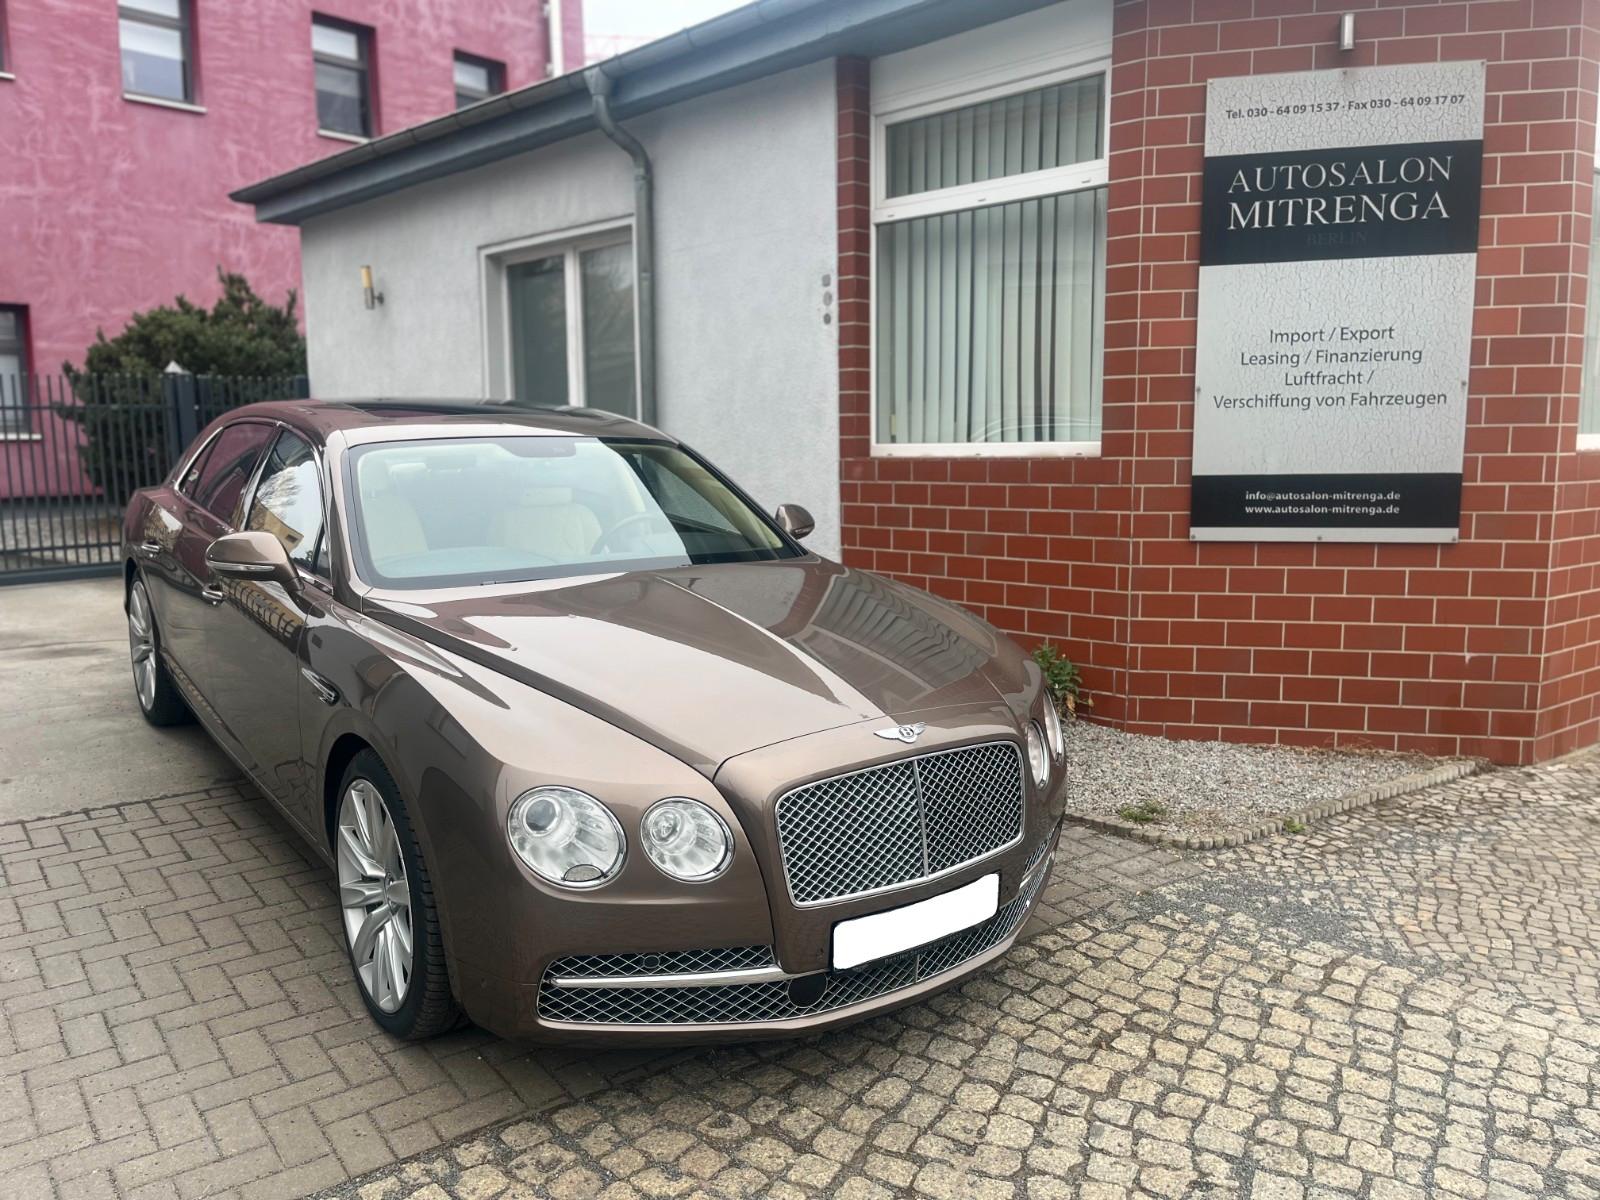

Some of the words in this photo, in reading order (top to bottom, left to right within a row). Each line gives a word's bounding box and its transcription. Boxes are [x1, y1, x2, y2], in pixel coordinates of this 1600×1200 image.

[1226, 109, 1245, 119] Tel.
[1293, 104, 1307, 114] 09
[1310, 103, 1323, 113] 15
[1325, 102, 1340, 112] 37
[1348, 101, 1368, 110] Fax
[1417, 96, 1431, 106] 09
[1435, 95, 1448, 105] 17
[1450, 94, 1465, 104] 07
[1227, 155, 1453, 194] AUTOSALON
[1227, 191, 1450, 230] MITRENGA
[1269, 329, 1325, 346] Import
[1340, 326, 1395, 344] Export
[1241, 352, 1300, 368] Leasing
[1315, 348, 1423, 364] Finanzierung
[1285, 371, 1363, 386] Luftfracht
[1213, 394, 1311, 411] Verschiffung
[1315, 396, 1346, 407] von
[1350, 392, 1448, 408] Fahrzeugen
[1245, 490, 1401, 503] info@autosalon-mitrenga.de
[1245, 504, 1400, 516] www.autosalon-mitrenga.de
